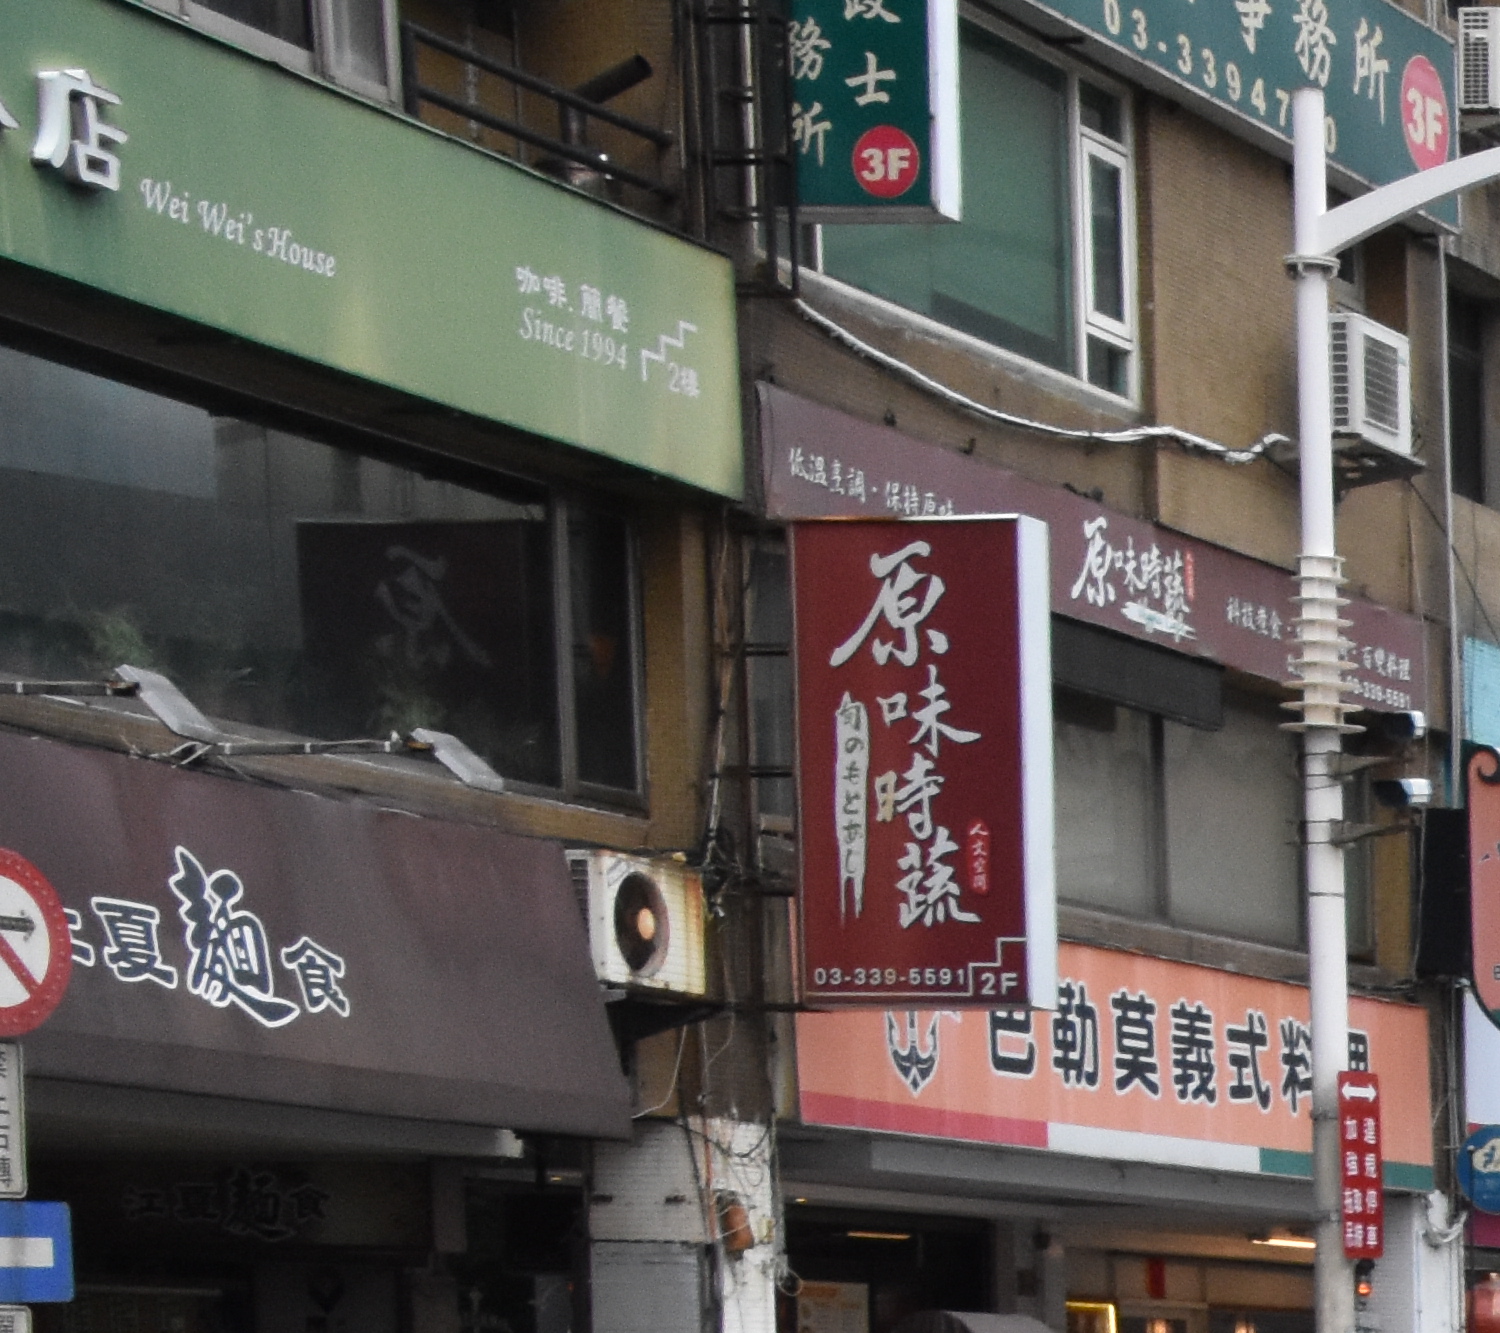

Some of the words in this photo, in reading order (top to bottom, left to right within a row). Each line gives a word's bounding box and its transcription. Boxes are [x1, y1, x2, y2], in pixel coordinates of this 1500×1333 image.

[1103, 0, 1338, 154] 03-339470
[1406, 88, 1443, 150] 3F
[0, 69, 128, 191] 店
[861, 148, 911, 181] 3F
[140, 178, 190, 224] Wei
[267, 226, 336, 278] House
[519, 307, 575, 351] Since
[581, 329, 627, 370] 1994
[1071, 517, 1191, 622] 原味時蔬
[829, 540, 981, 928] 原味時蔬
[814, 966, 965, 986] 03-339-5591
[981, 972, 1018, 994] 2F
